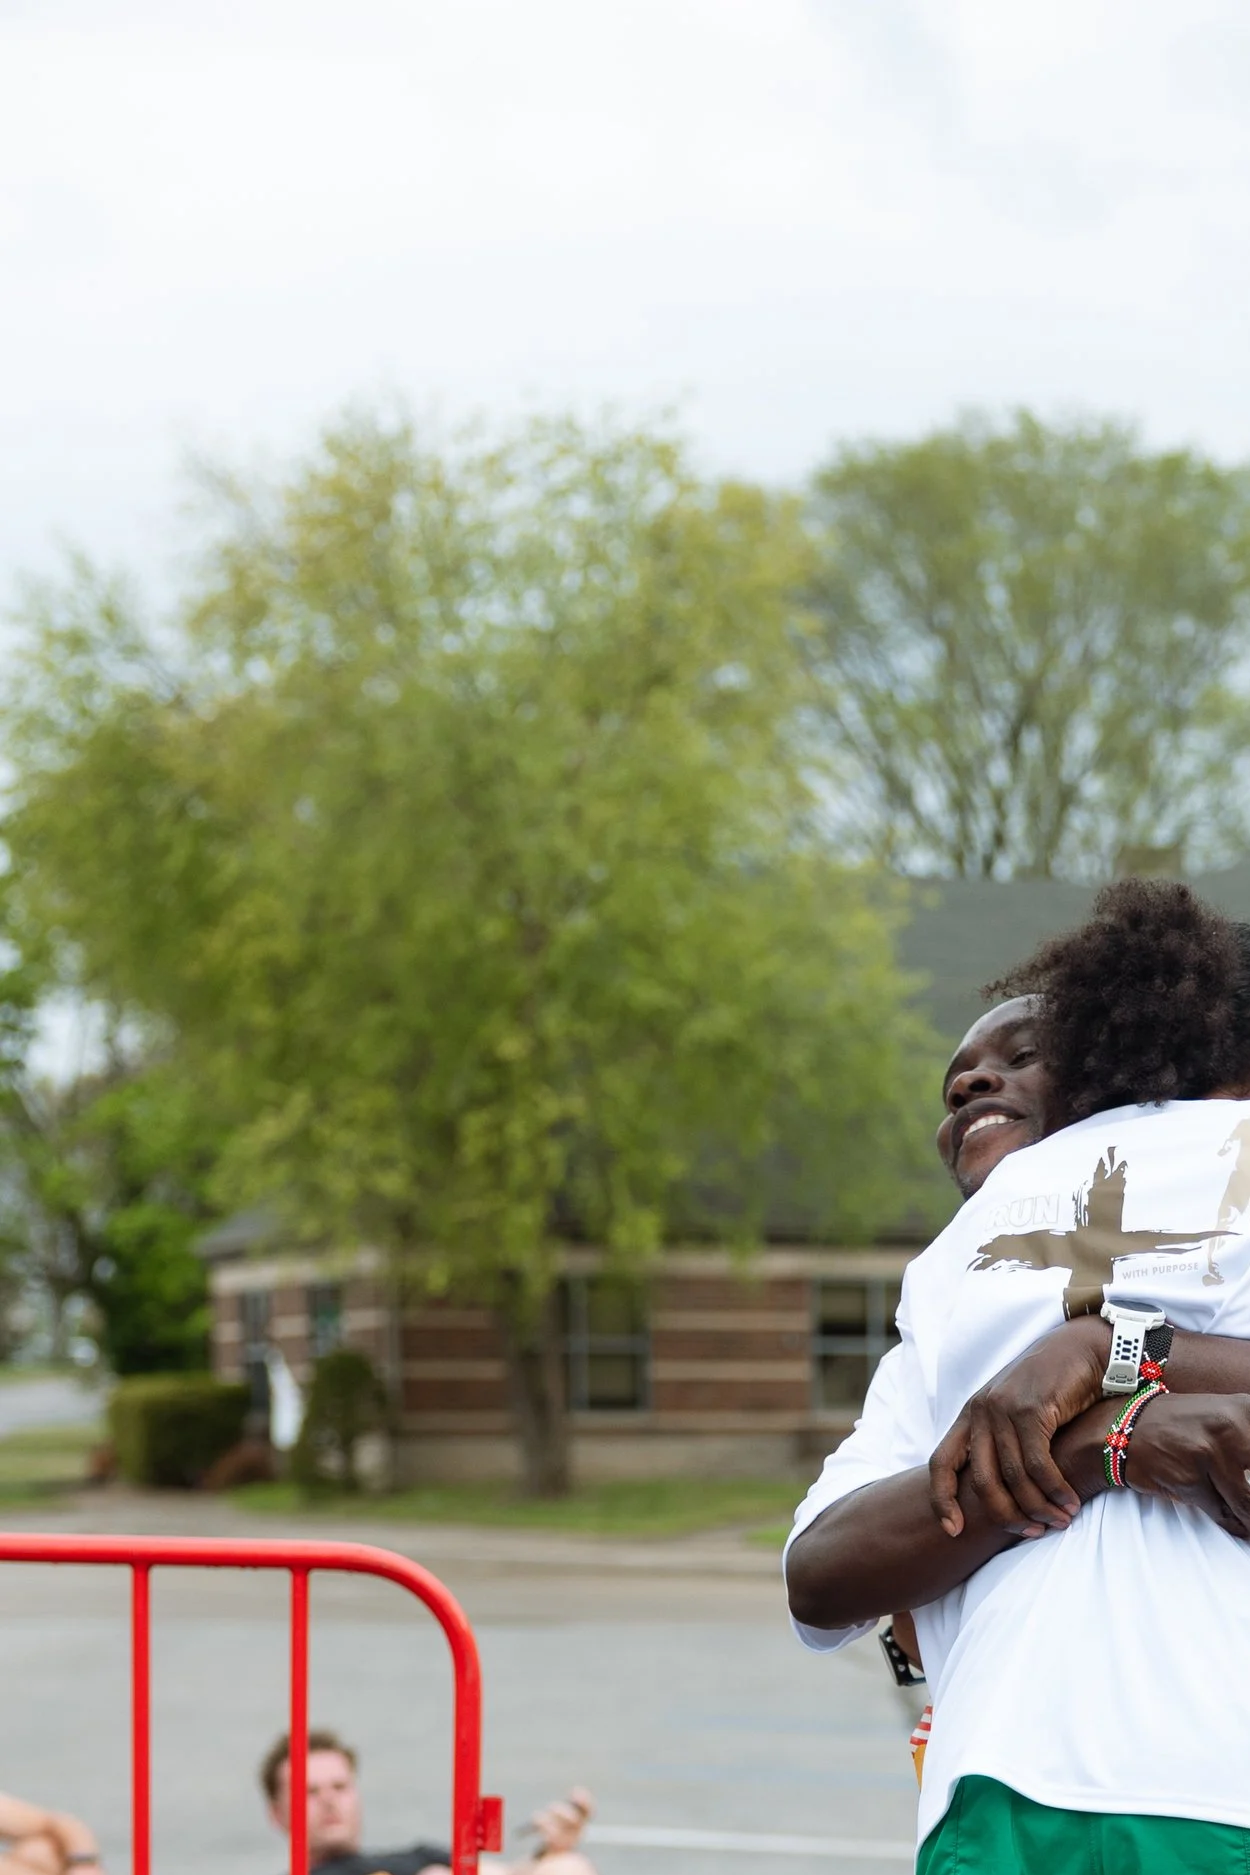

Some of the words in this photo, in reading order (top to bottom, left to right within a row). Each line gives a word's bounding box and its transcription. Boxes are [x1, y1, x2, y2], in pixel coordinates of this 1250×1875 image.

[985, 1194, 1060, 1231] RUN
[1122, 1267, 1149, 1281] WITH
[1152, 1262, 1199, 1276] PURPOSE
